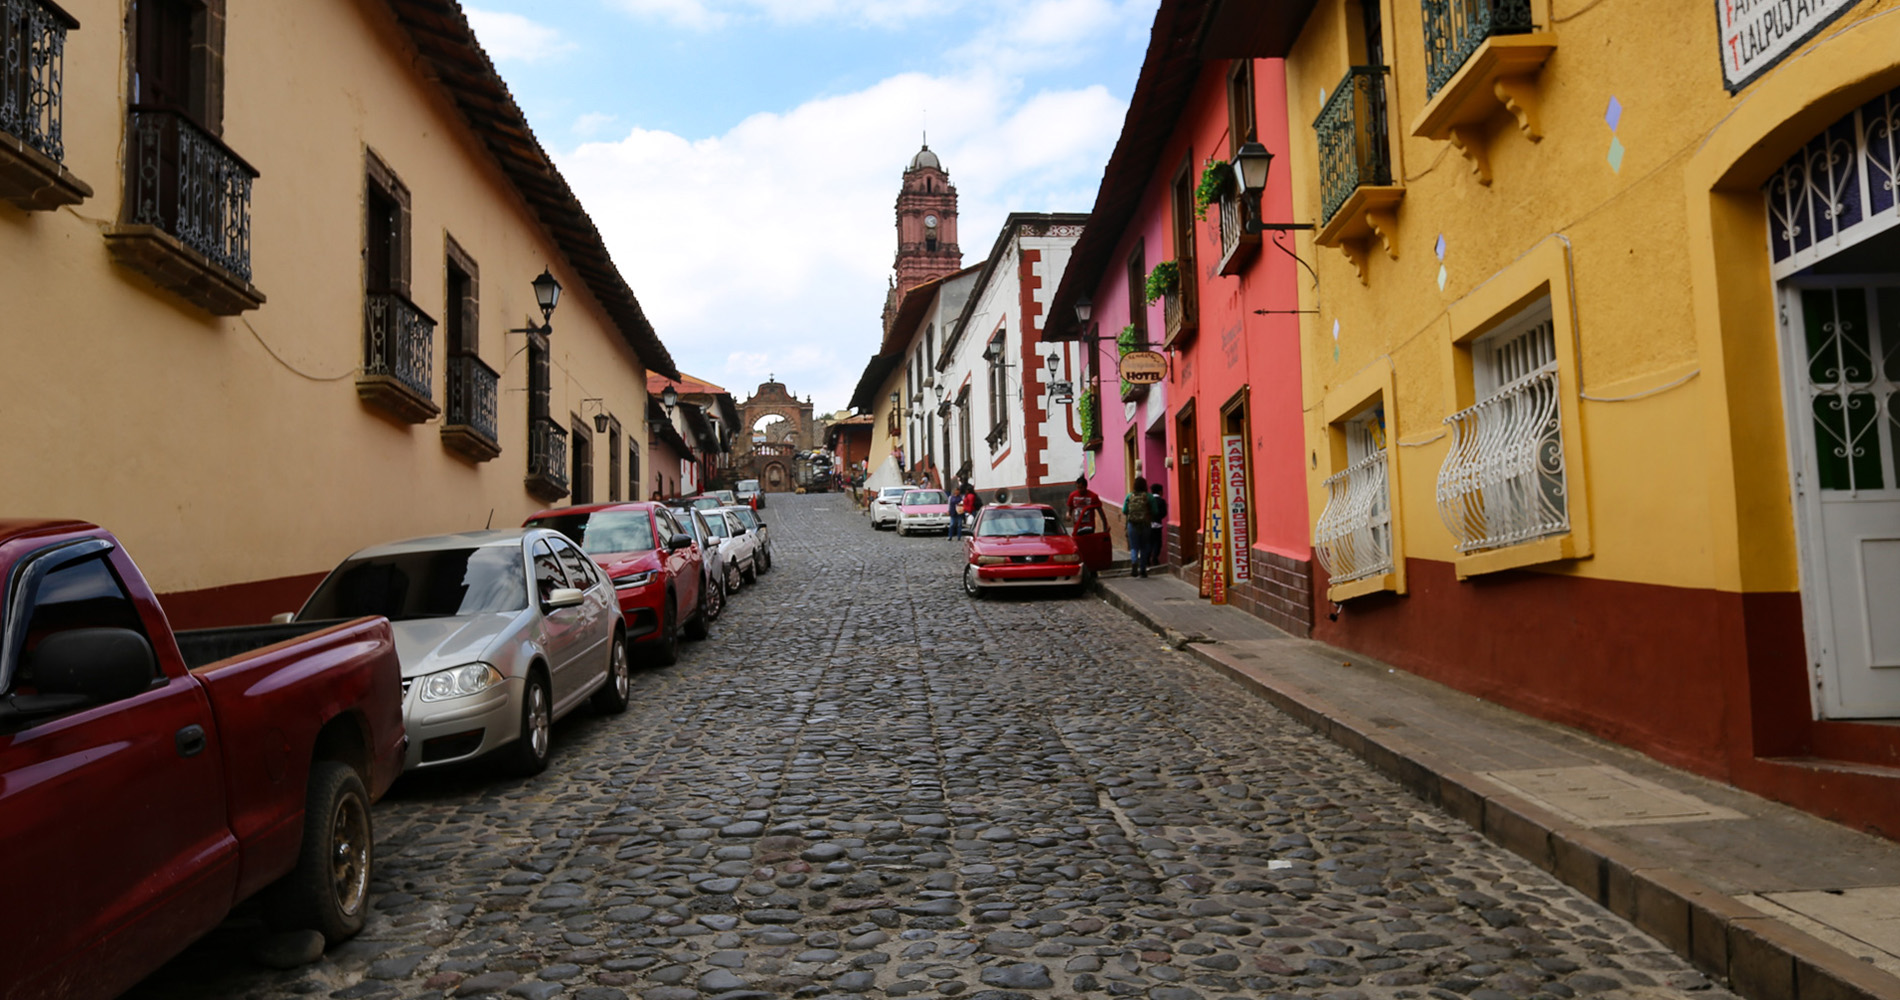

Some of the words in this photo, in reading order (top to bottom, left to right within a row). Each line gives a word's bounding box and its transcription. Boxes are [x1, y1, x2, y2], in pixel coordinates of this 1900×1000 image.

[1126, 371, 1161, 381] HOTEL
[1211, 459, 1221, 509] FARMACIA
[1227, 439, 1246, 502] FARMACIA
[1212, 542, 1224, 602] SIMILARES
[1232, 514, 1249, 579] DESCUENTO
